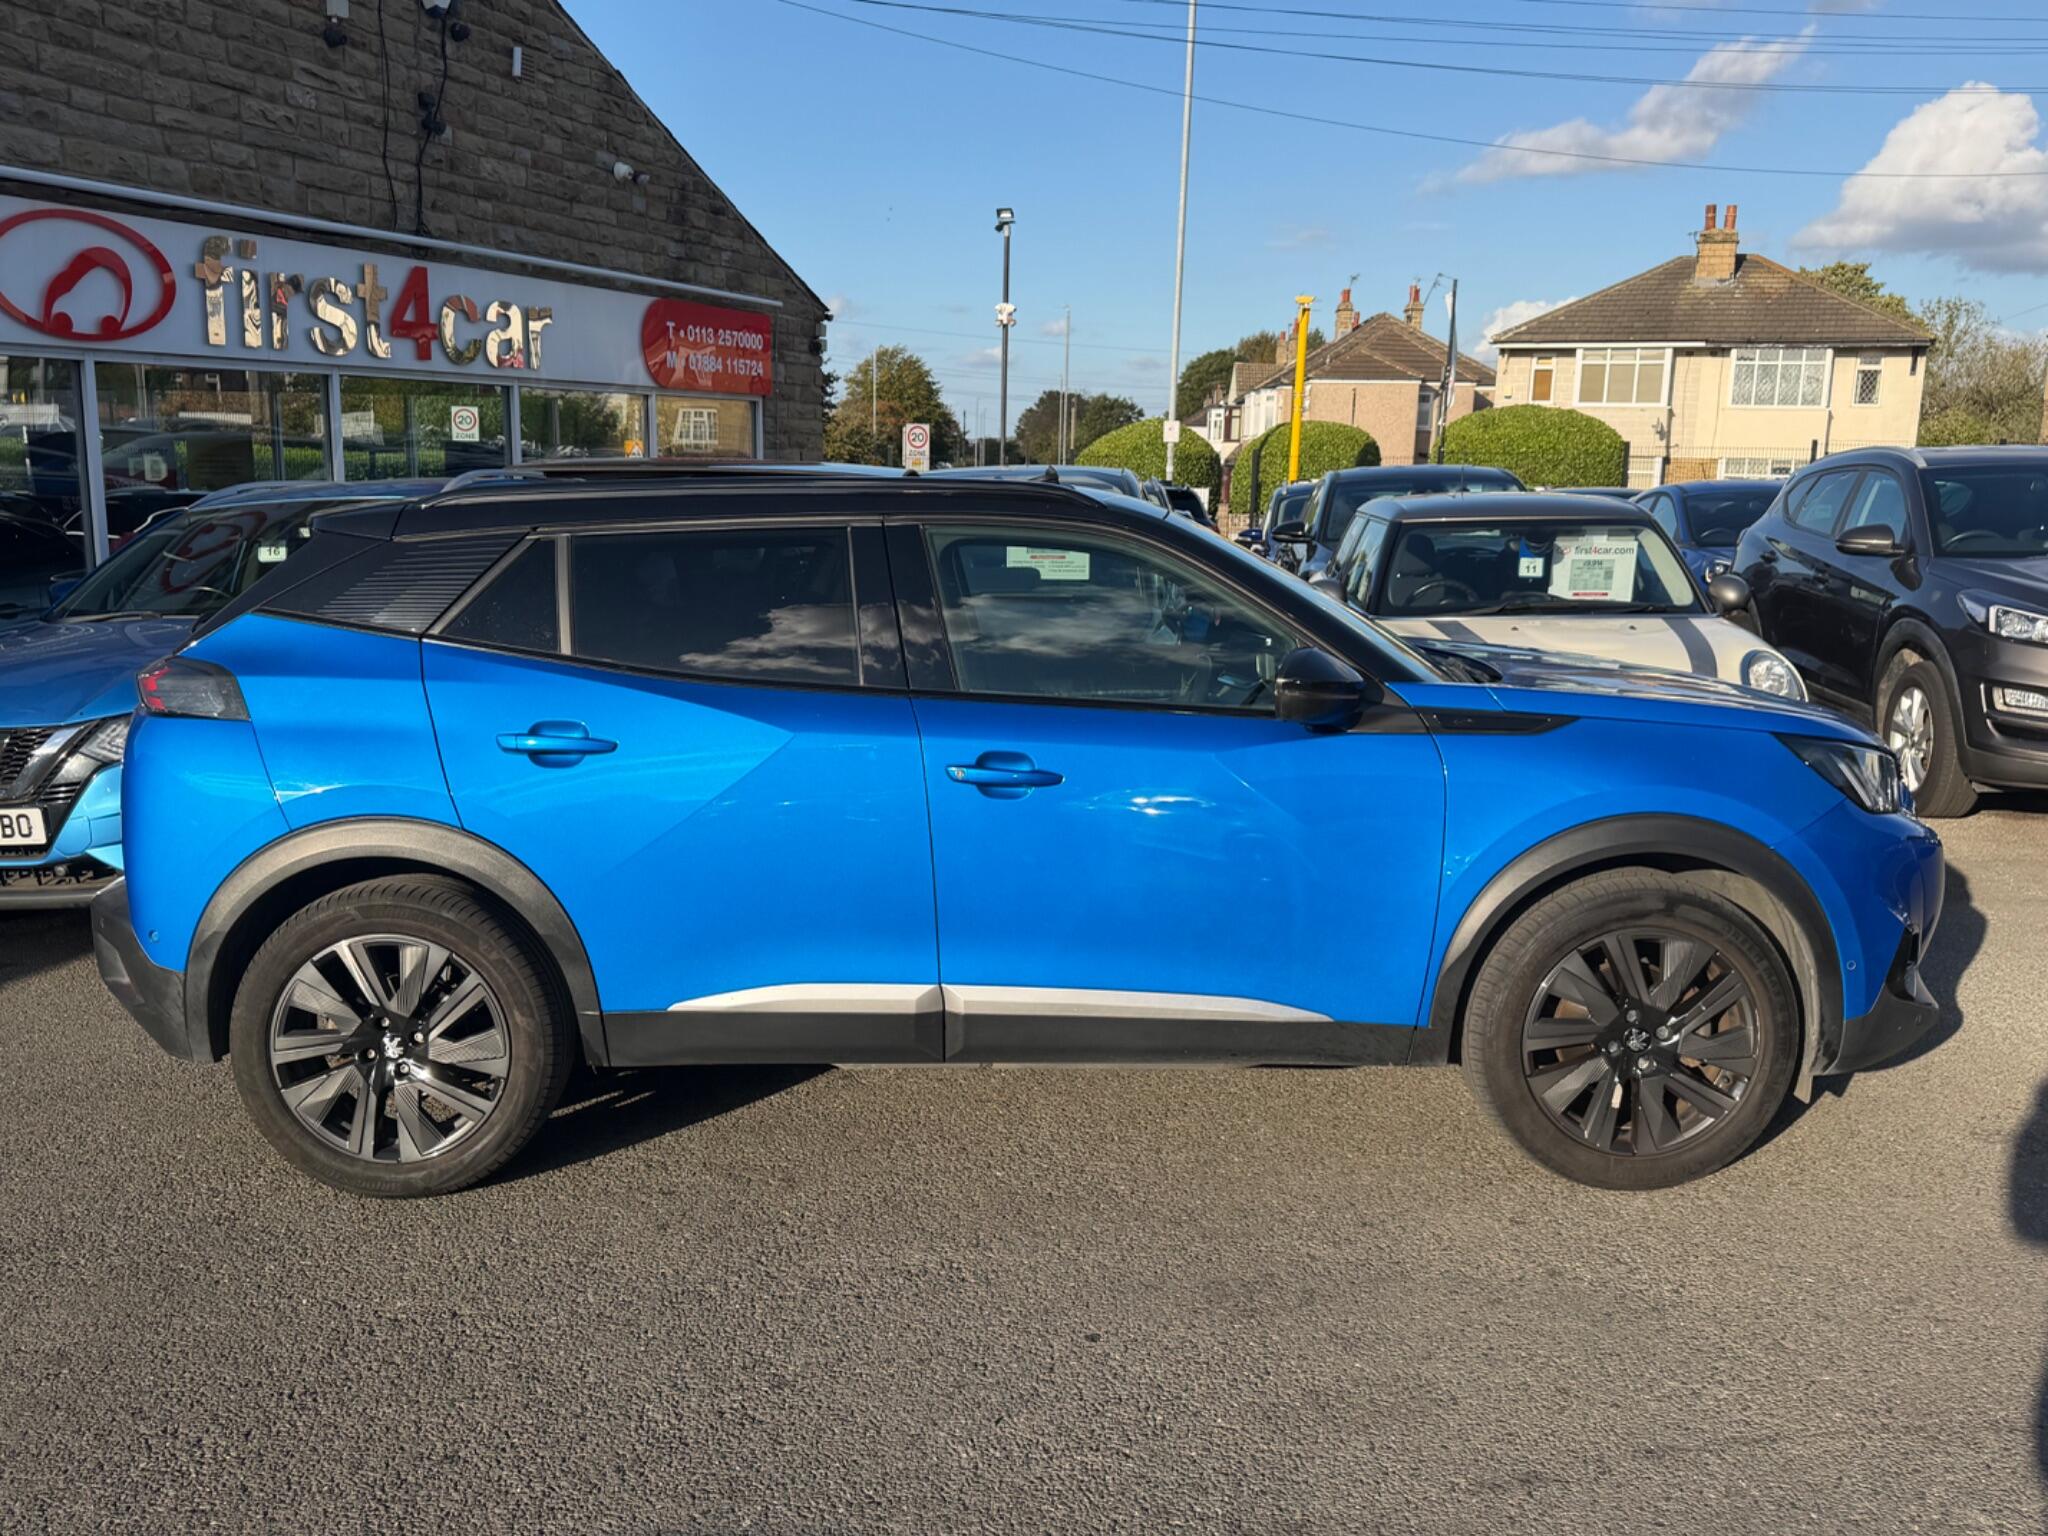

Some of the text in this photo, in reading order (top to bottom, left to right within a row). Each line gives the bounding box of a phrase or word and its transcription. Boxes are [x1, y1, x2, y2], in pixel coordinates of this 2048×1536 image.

[194, 235, 553, 371] first4car
[687, 325, 714, 343] 0113
[718, 329, 764, 350] 2570000
[726, 357, 764, 377] 115724
[457, 415, 473, 425] 20
[911, 432, 925, 443] 20
[1574, 545, 1635, 555] first4car.com
[1525, 564, 1538, 573] 11
